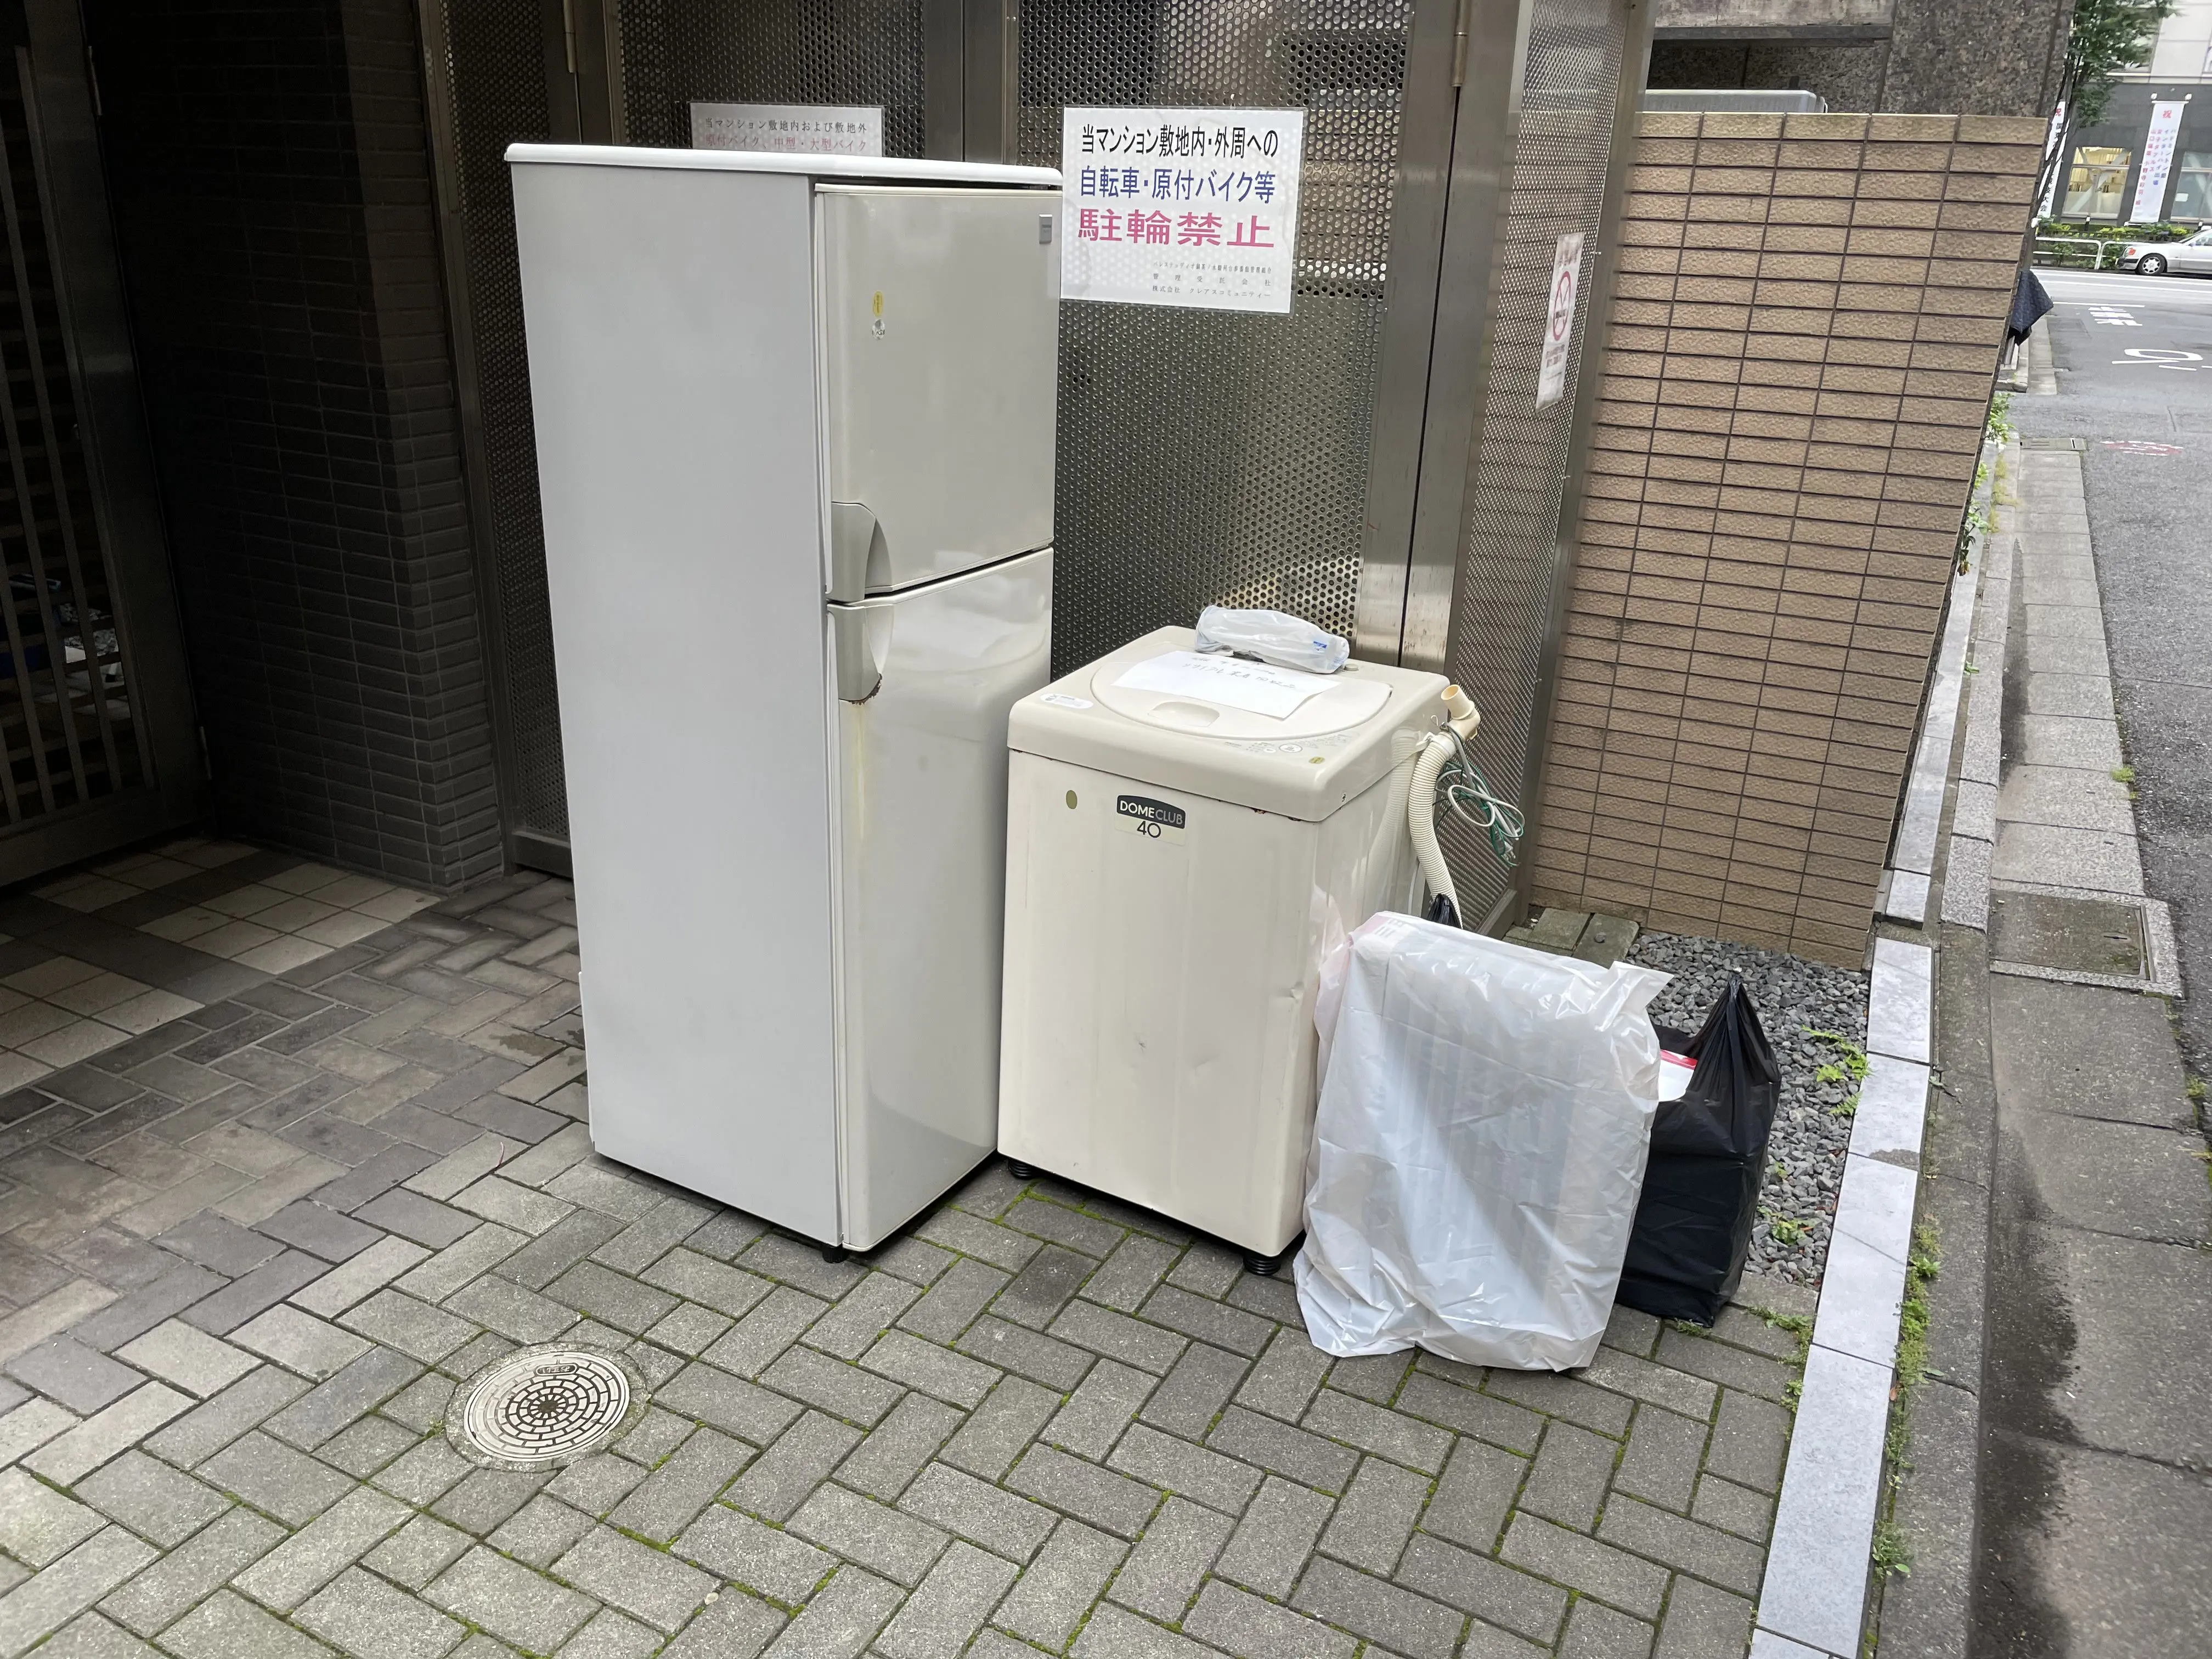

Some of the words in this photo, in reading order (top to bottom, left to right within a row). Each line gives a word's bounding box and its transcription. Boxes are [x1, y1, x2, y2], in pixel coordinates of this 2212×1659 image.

[706, 117, 867, 134] 当マンション敷地内および敷地外
[2163, 110, 2172, 119] 祝
[1081, 124, 1278, 159] 当マンション敷地内・外周への
[1081, 166, 1276, 204] 自転車・原付バイク等
[1077, 208, 1274, 248] 駐輪禁止
[1137, 821, 1161, 838] 40
